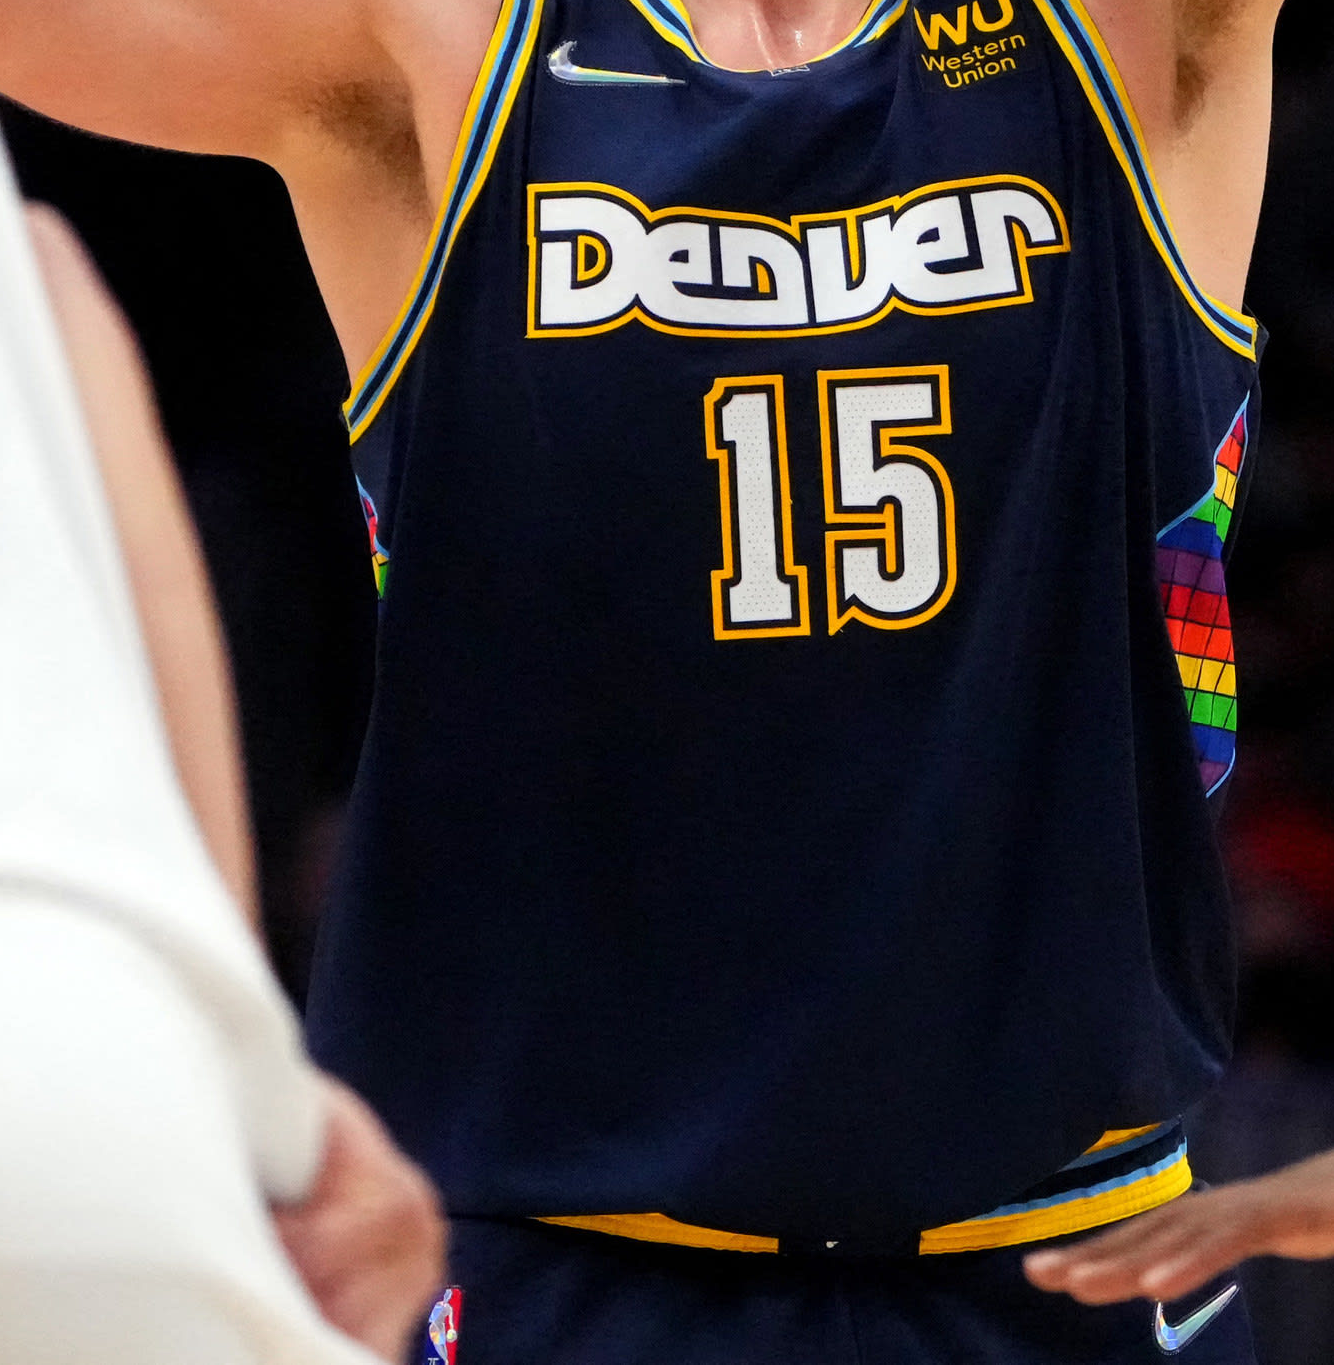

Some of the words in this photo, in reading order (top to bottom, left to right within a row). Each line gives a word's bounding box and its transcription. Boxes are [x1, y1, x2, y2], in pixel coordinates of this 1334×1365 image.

[921, 34, 1026, 72] Western
[943, 57, 1017, 88] Union
[704, 365, 958, 640] 15
